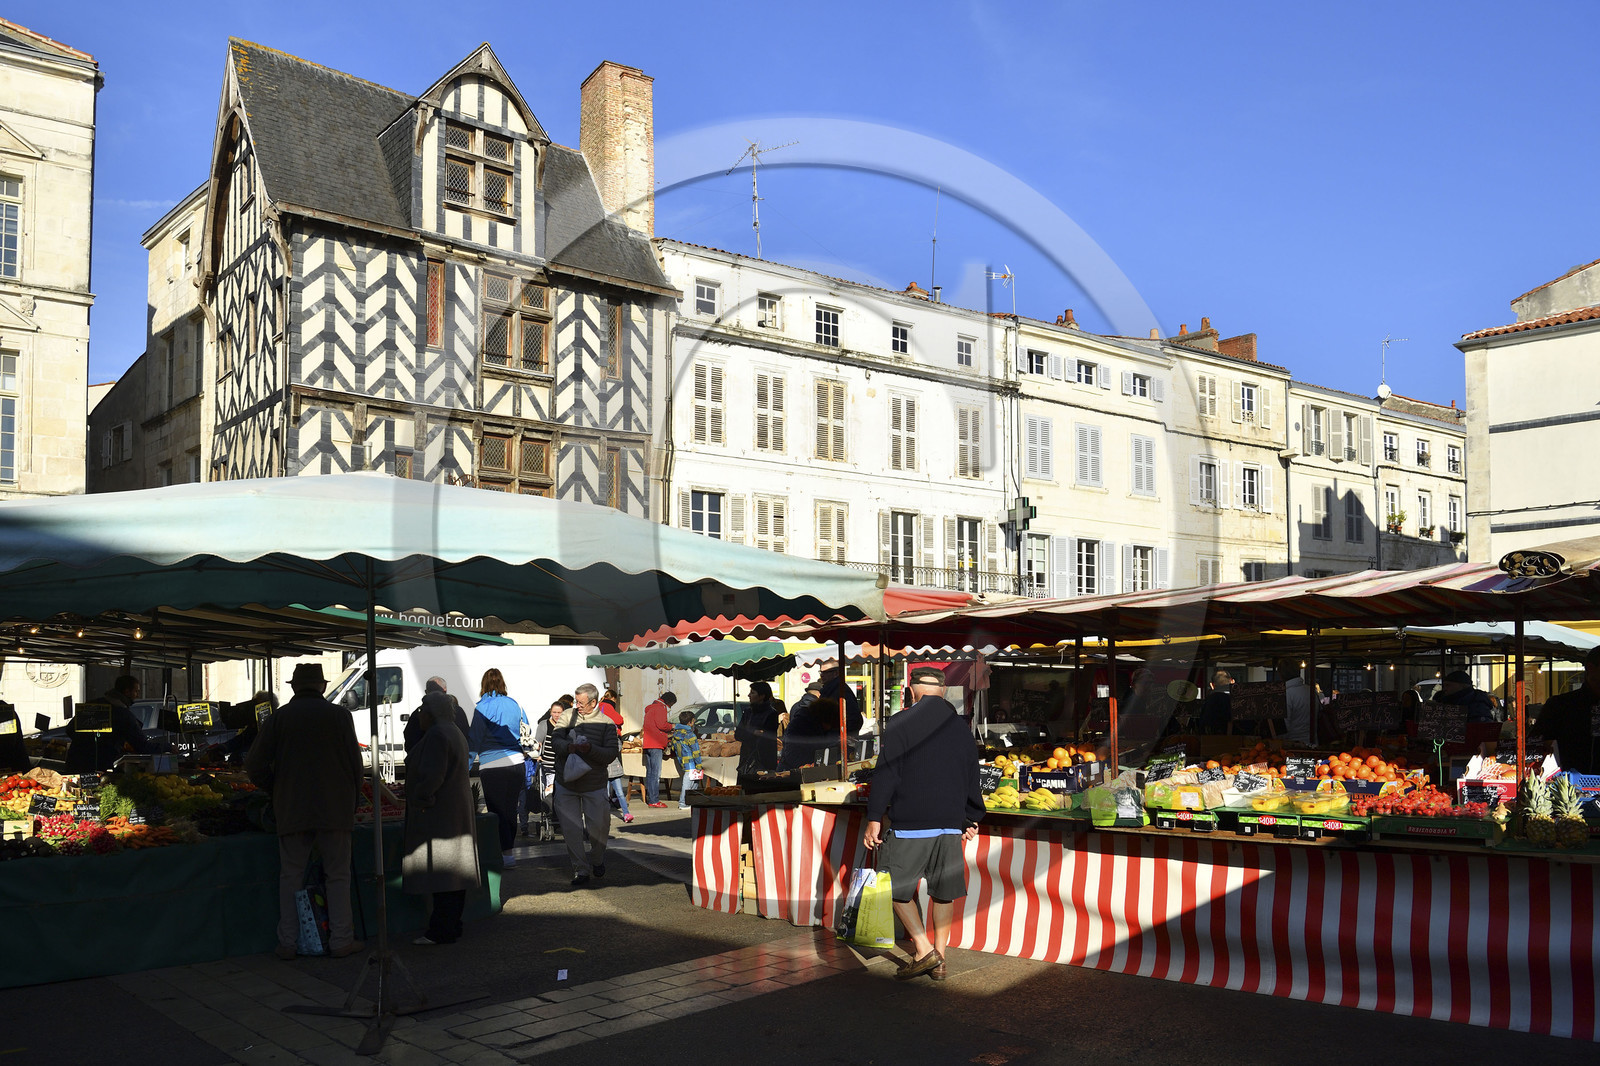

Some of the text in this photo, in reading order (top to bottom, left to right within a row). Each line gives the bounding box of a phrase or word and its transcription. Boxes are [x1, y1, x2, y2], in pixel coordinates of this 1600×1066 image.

[1041, 778, 1067, 789] GAMIN
[1176, 812, 1193, 820] TROPS
[1259, 816, 1276, 825] TROPS
[1323, 821, 1343, 830] TROPS
